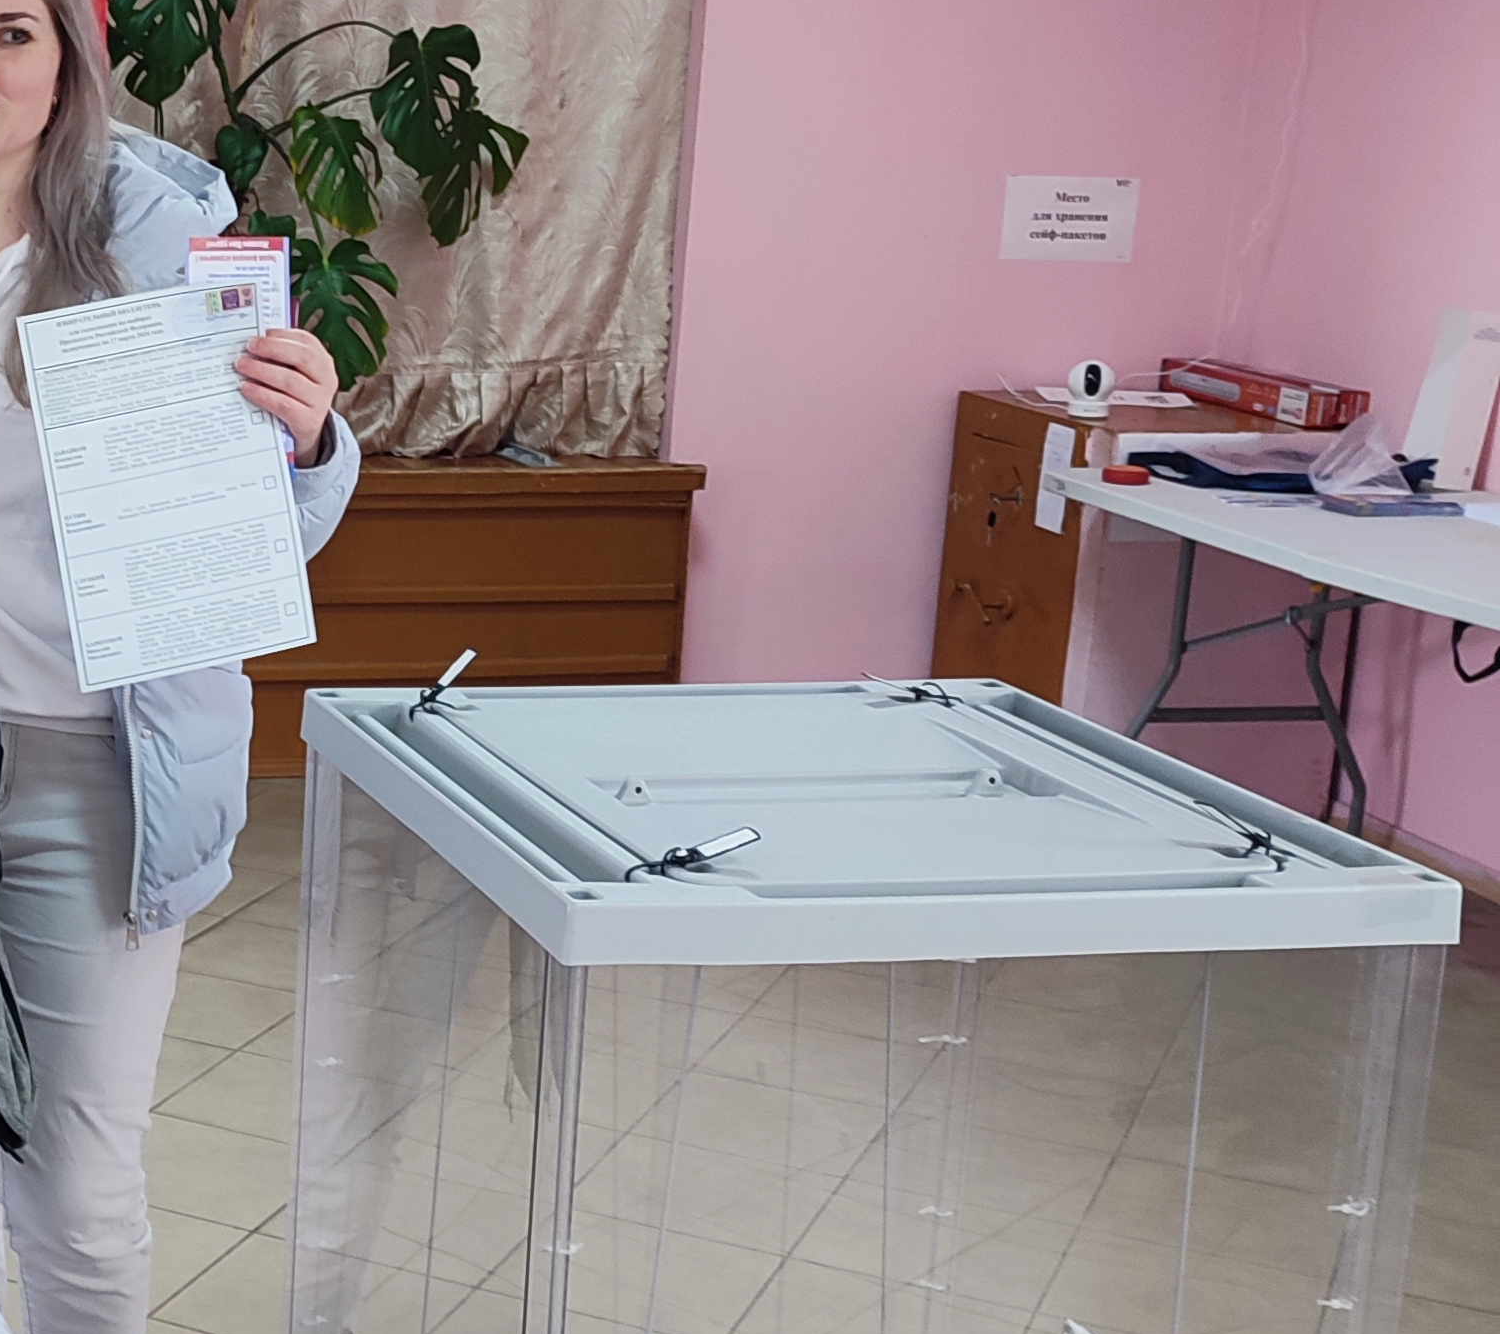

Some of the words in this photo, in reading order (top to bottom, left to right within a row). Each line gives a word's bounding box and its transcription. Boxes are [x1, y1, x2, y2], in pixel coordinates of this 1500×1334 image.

[1054, 191, 1091, 203] Место
[1031, 213, 1052, 221] для
[1055, 213, 1109, 223] хранения
[1029, 229, 1107, 242] сейф-пакетов
